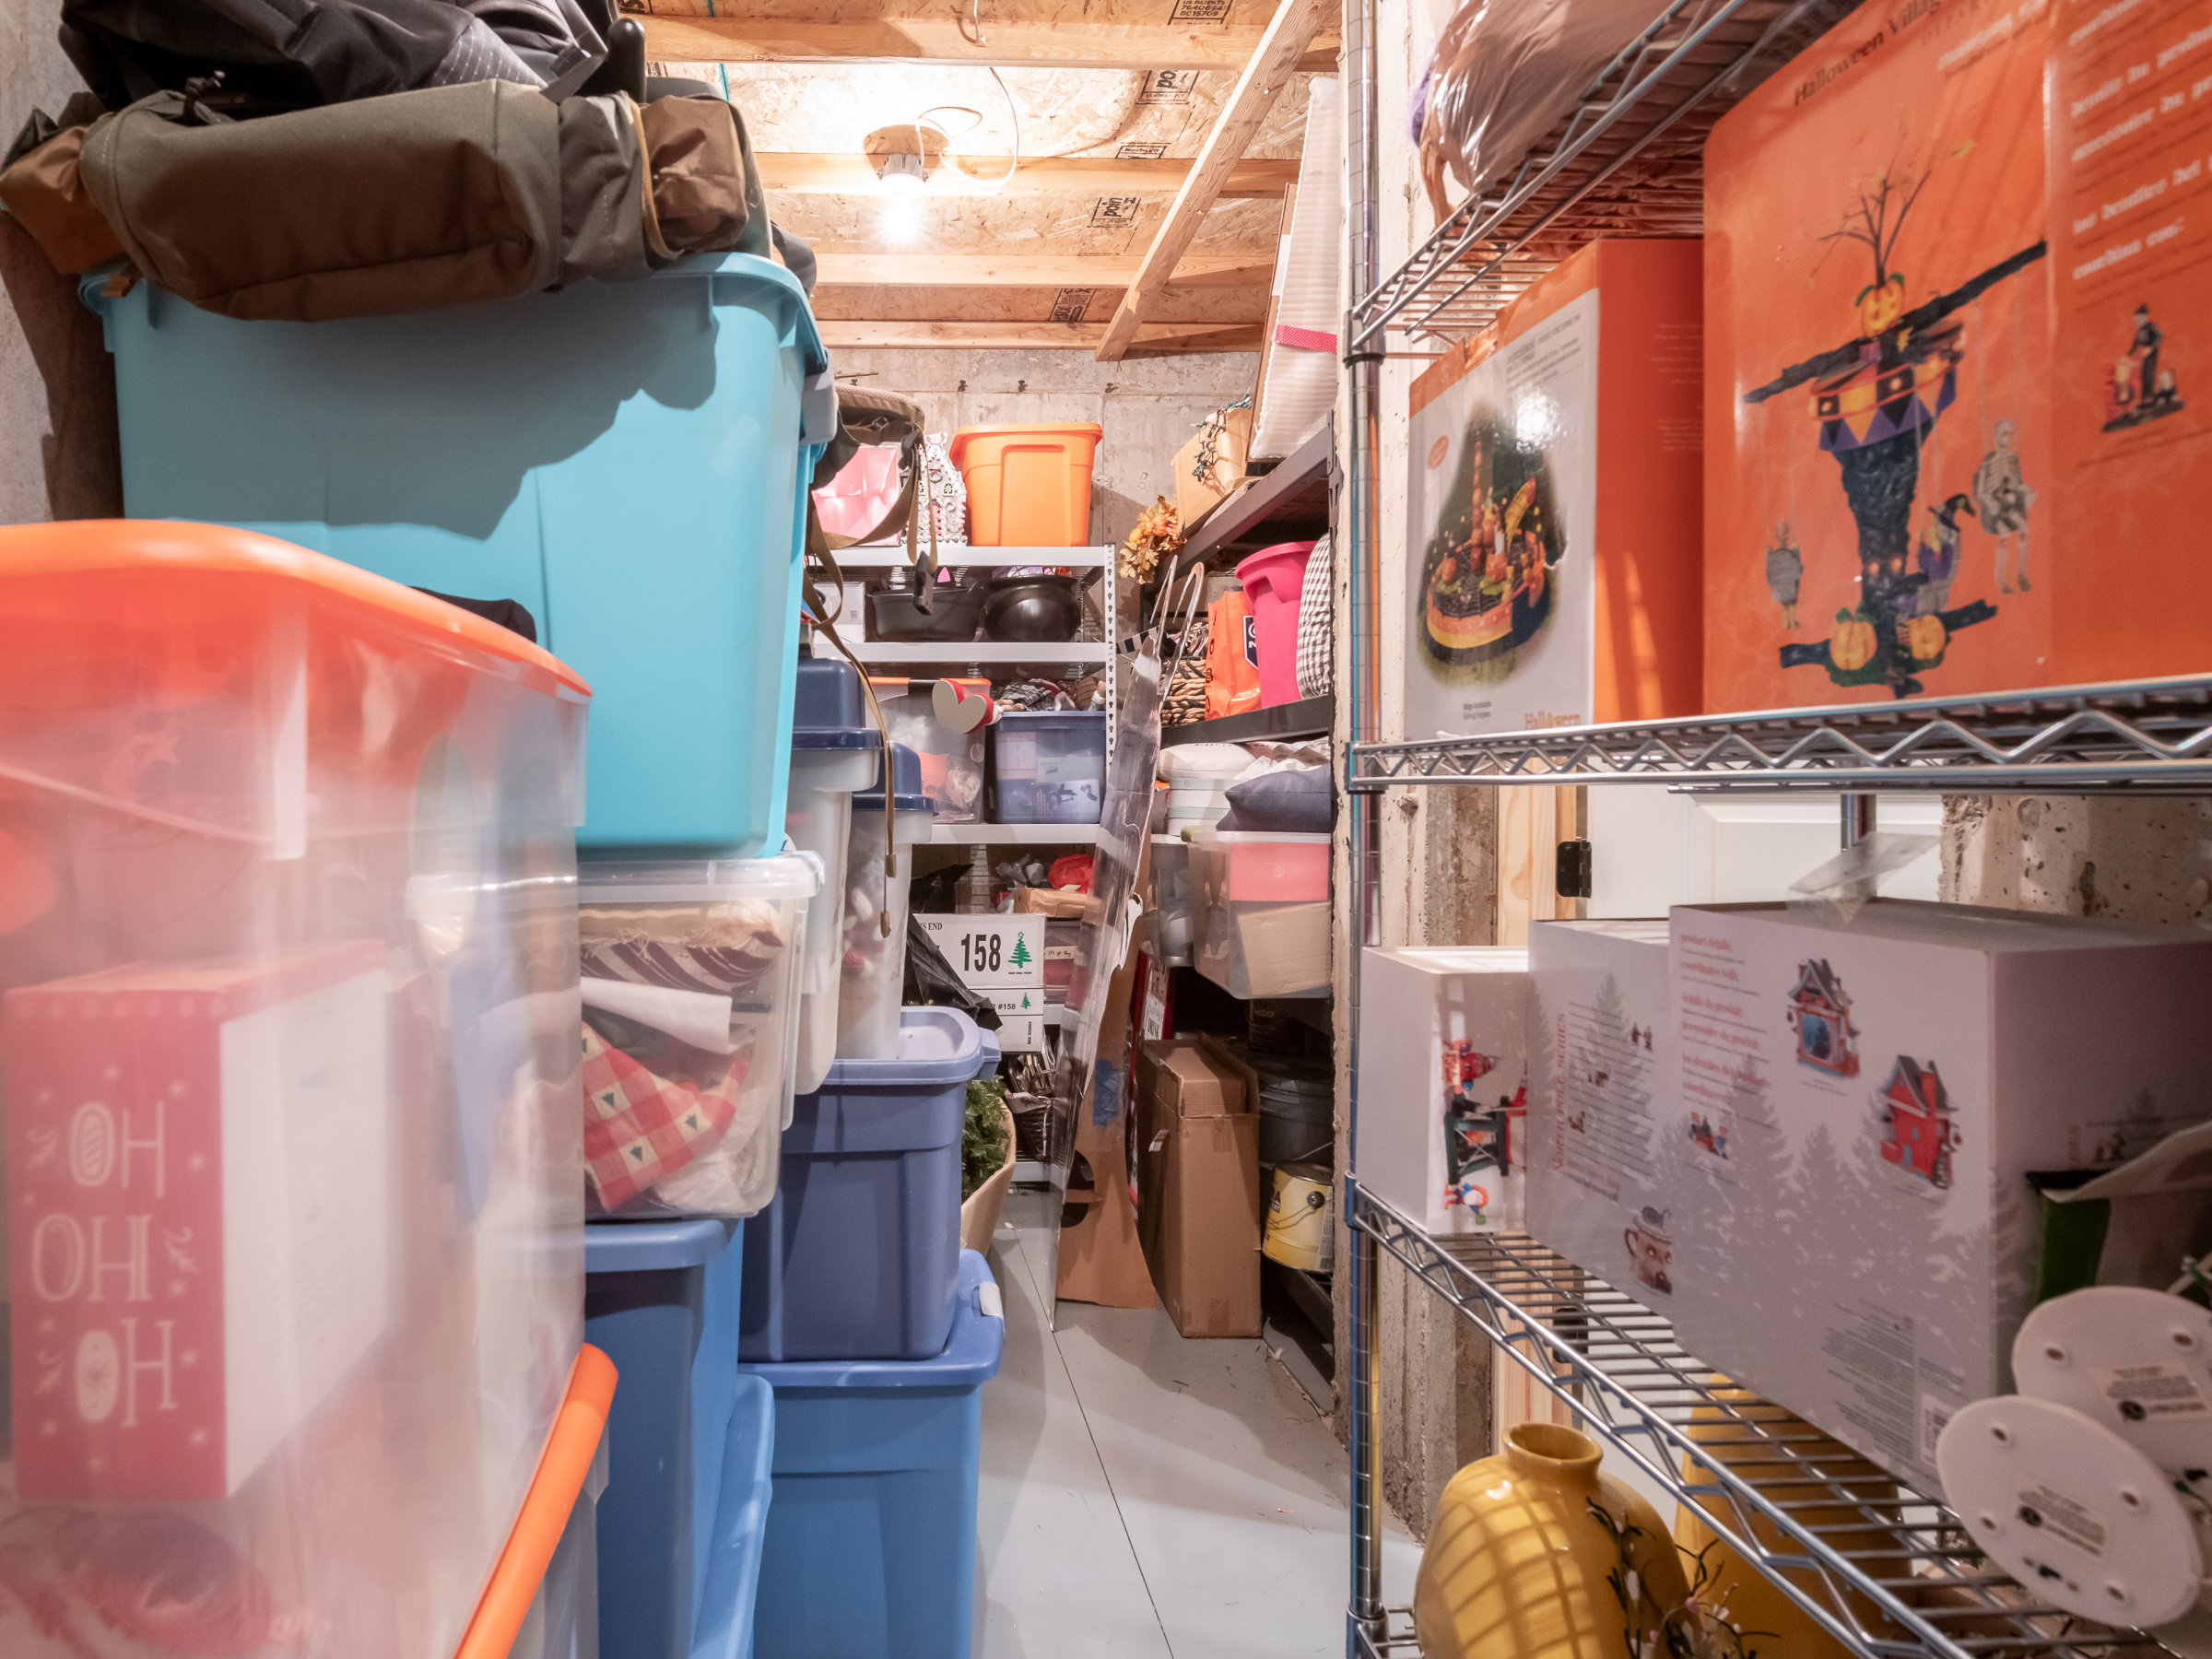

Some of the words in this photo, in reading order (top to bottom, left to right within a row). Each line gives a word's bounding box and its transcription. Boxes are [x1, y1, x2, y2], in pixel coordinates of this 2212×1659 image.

[1794, 31, 1884, 106] Halloween
[928, 923, 943, 931] END
[960, 933, 1002, 972] 158
